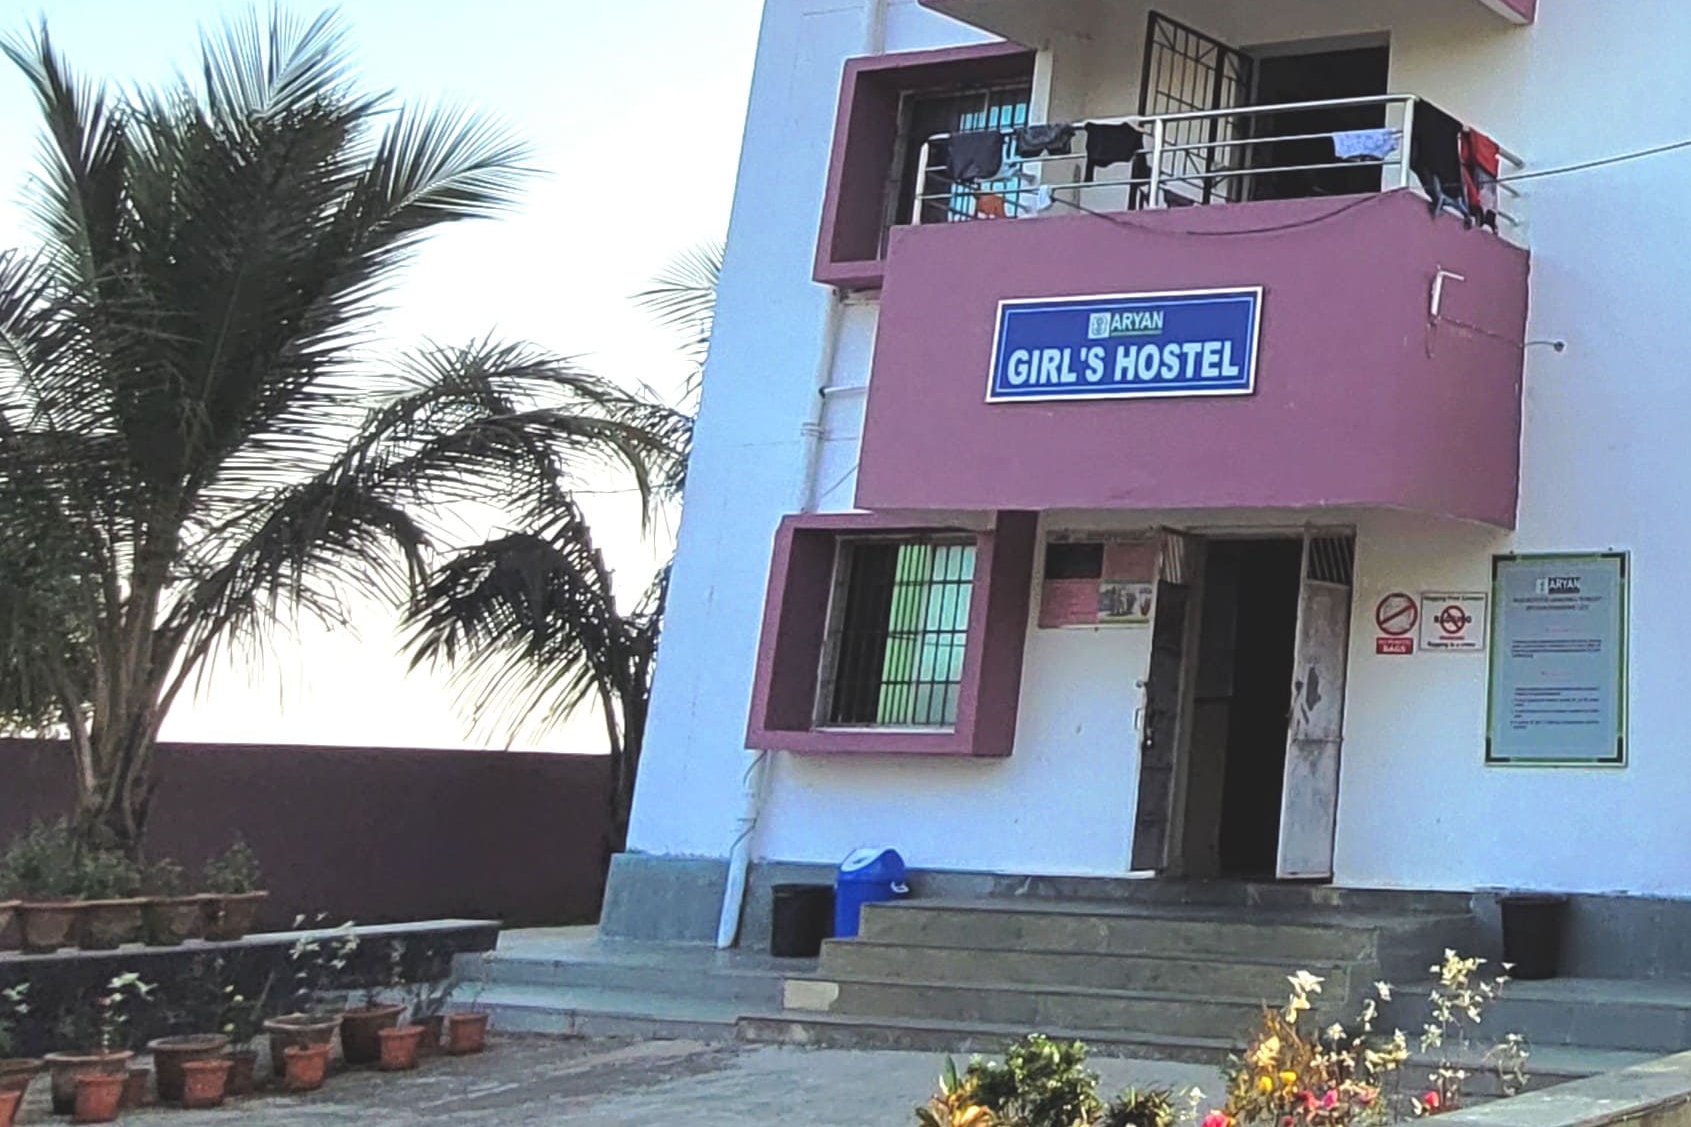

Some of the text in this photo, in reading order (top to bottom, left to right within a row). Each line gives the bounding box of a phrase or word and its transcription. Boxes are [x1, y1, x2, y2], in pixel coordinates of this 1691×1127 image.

[1110, 311, 1164, 331] ARYAN
[1007, 341, 1240, 385] GIRL'S HOSTEL
